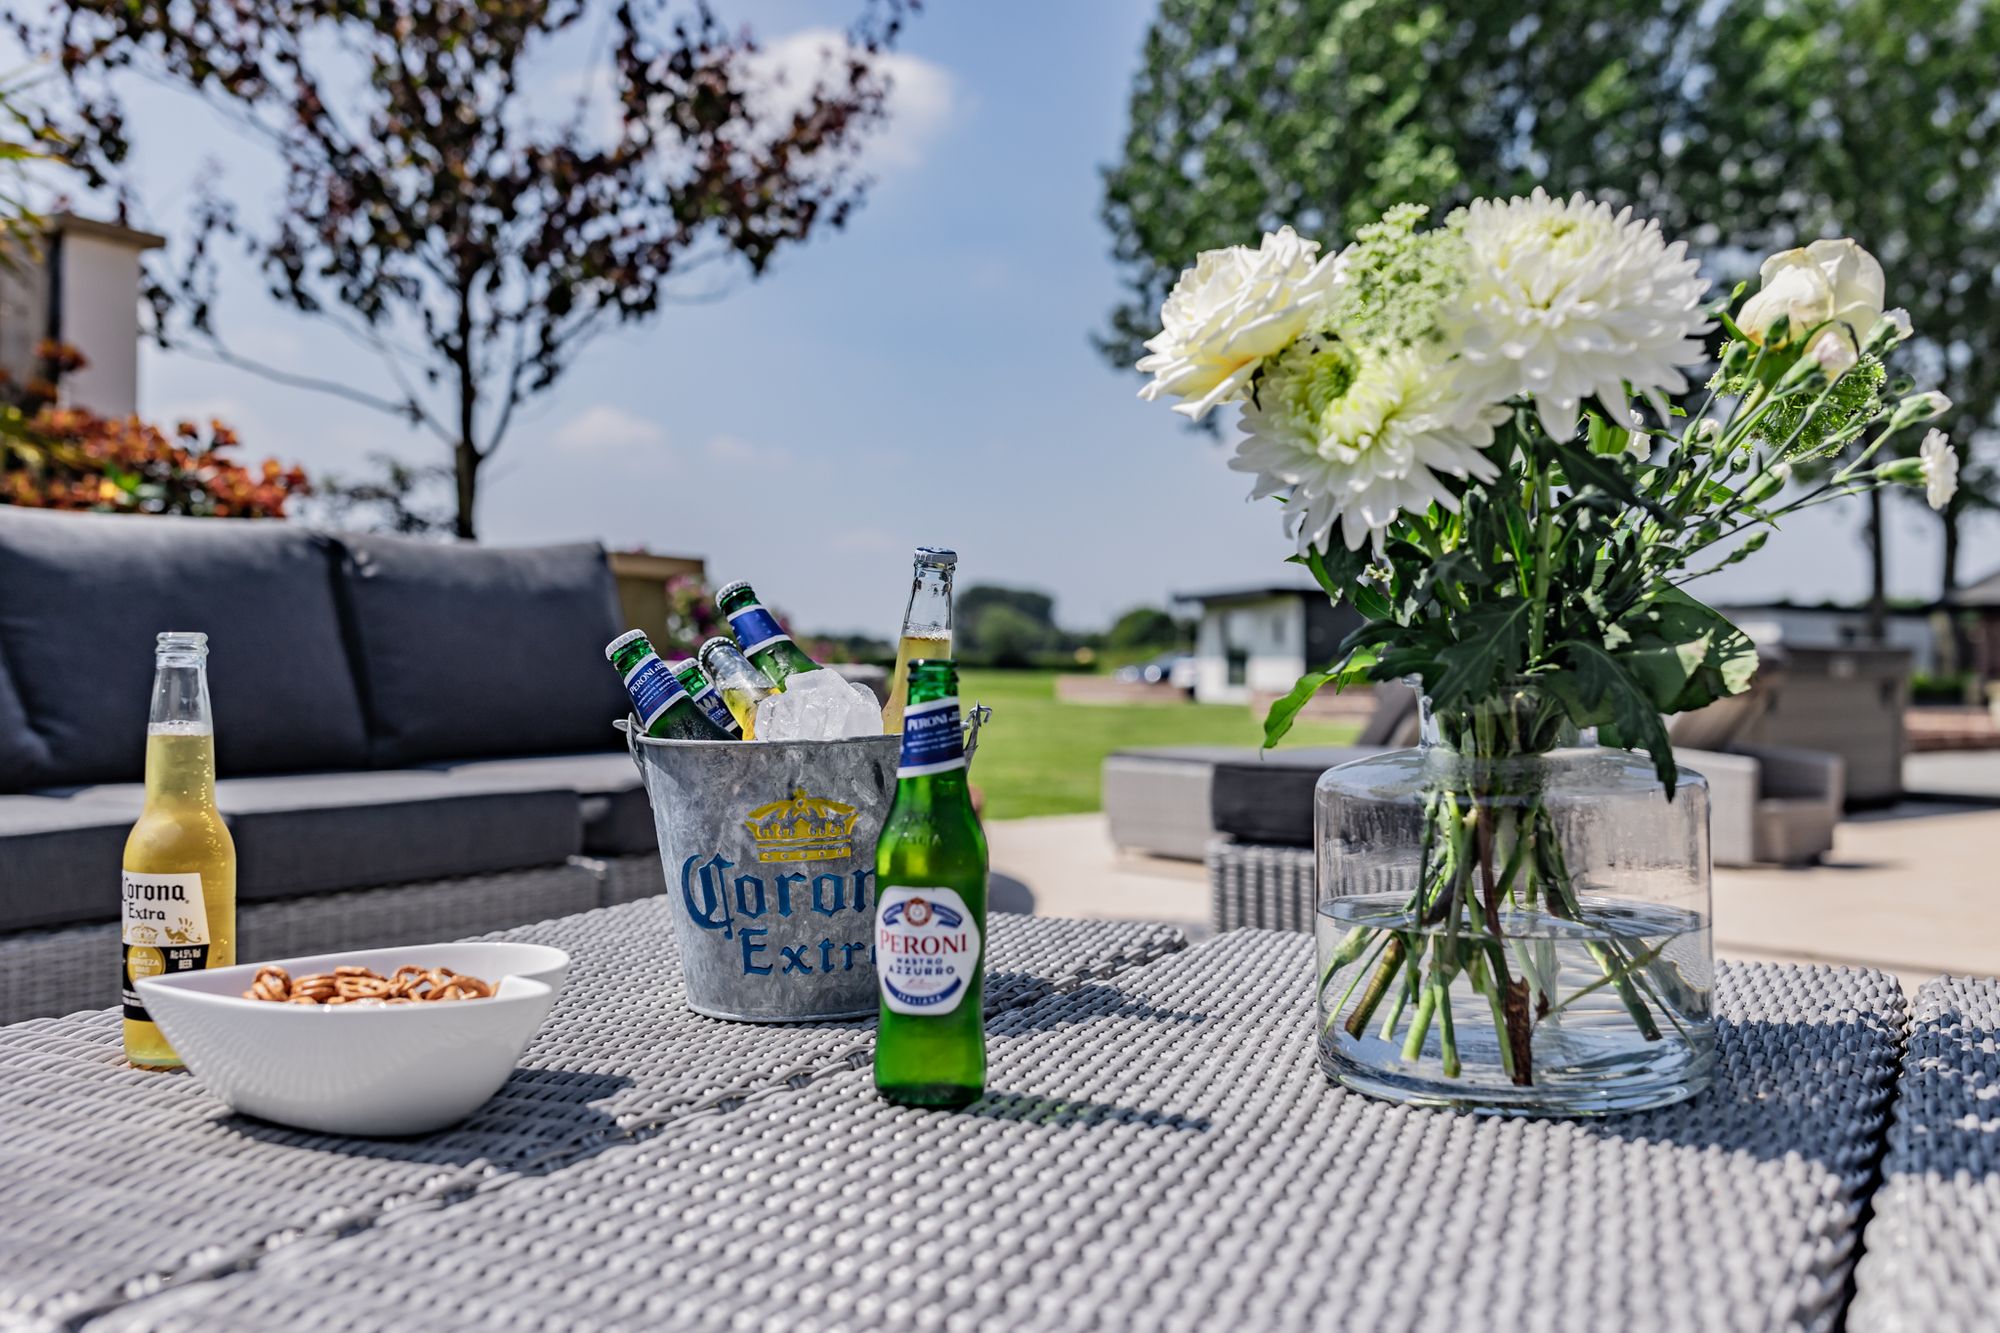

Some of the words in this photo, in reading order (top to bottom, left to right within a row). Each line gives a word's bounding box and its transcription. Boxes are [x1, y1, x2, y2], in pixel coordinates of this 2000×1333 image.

[629, 667, 656, 696] PERONI
[681, 852, 876, 940] Coron
[129, 902, 166, 920] Extra
[738, 927, 877, 976] Extr
[880, 928, 967, 955] PERONI
[888, 966, 955, 976] AZZURRO
